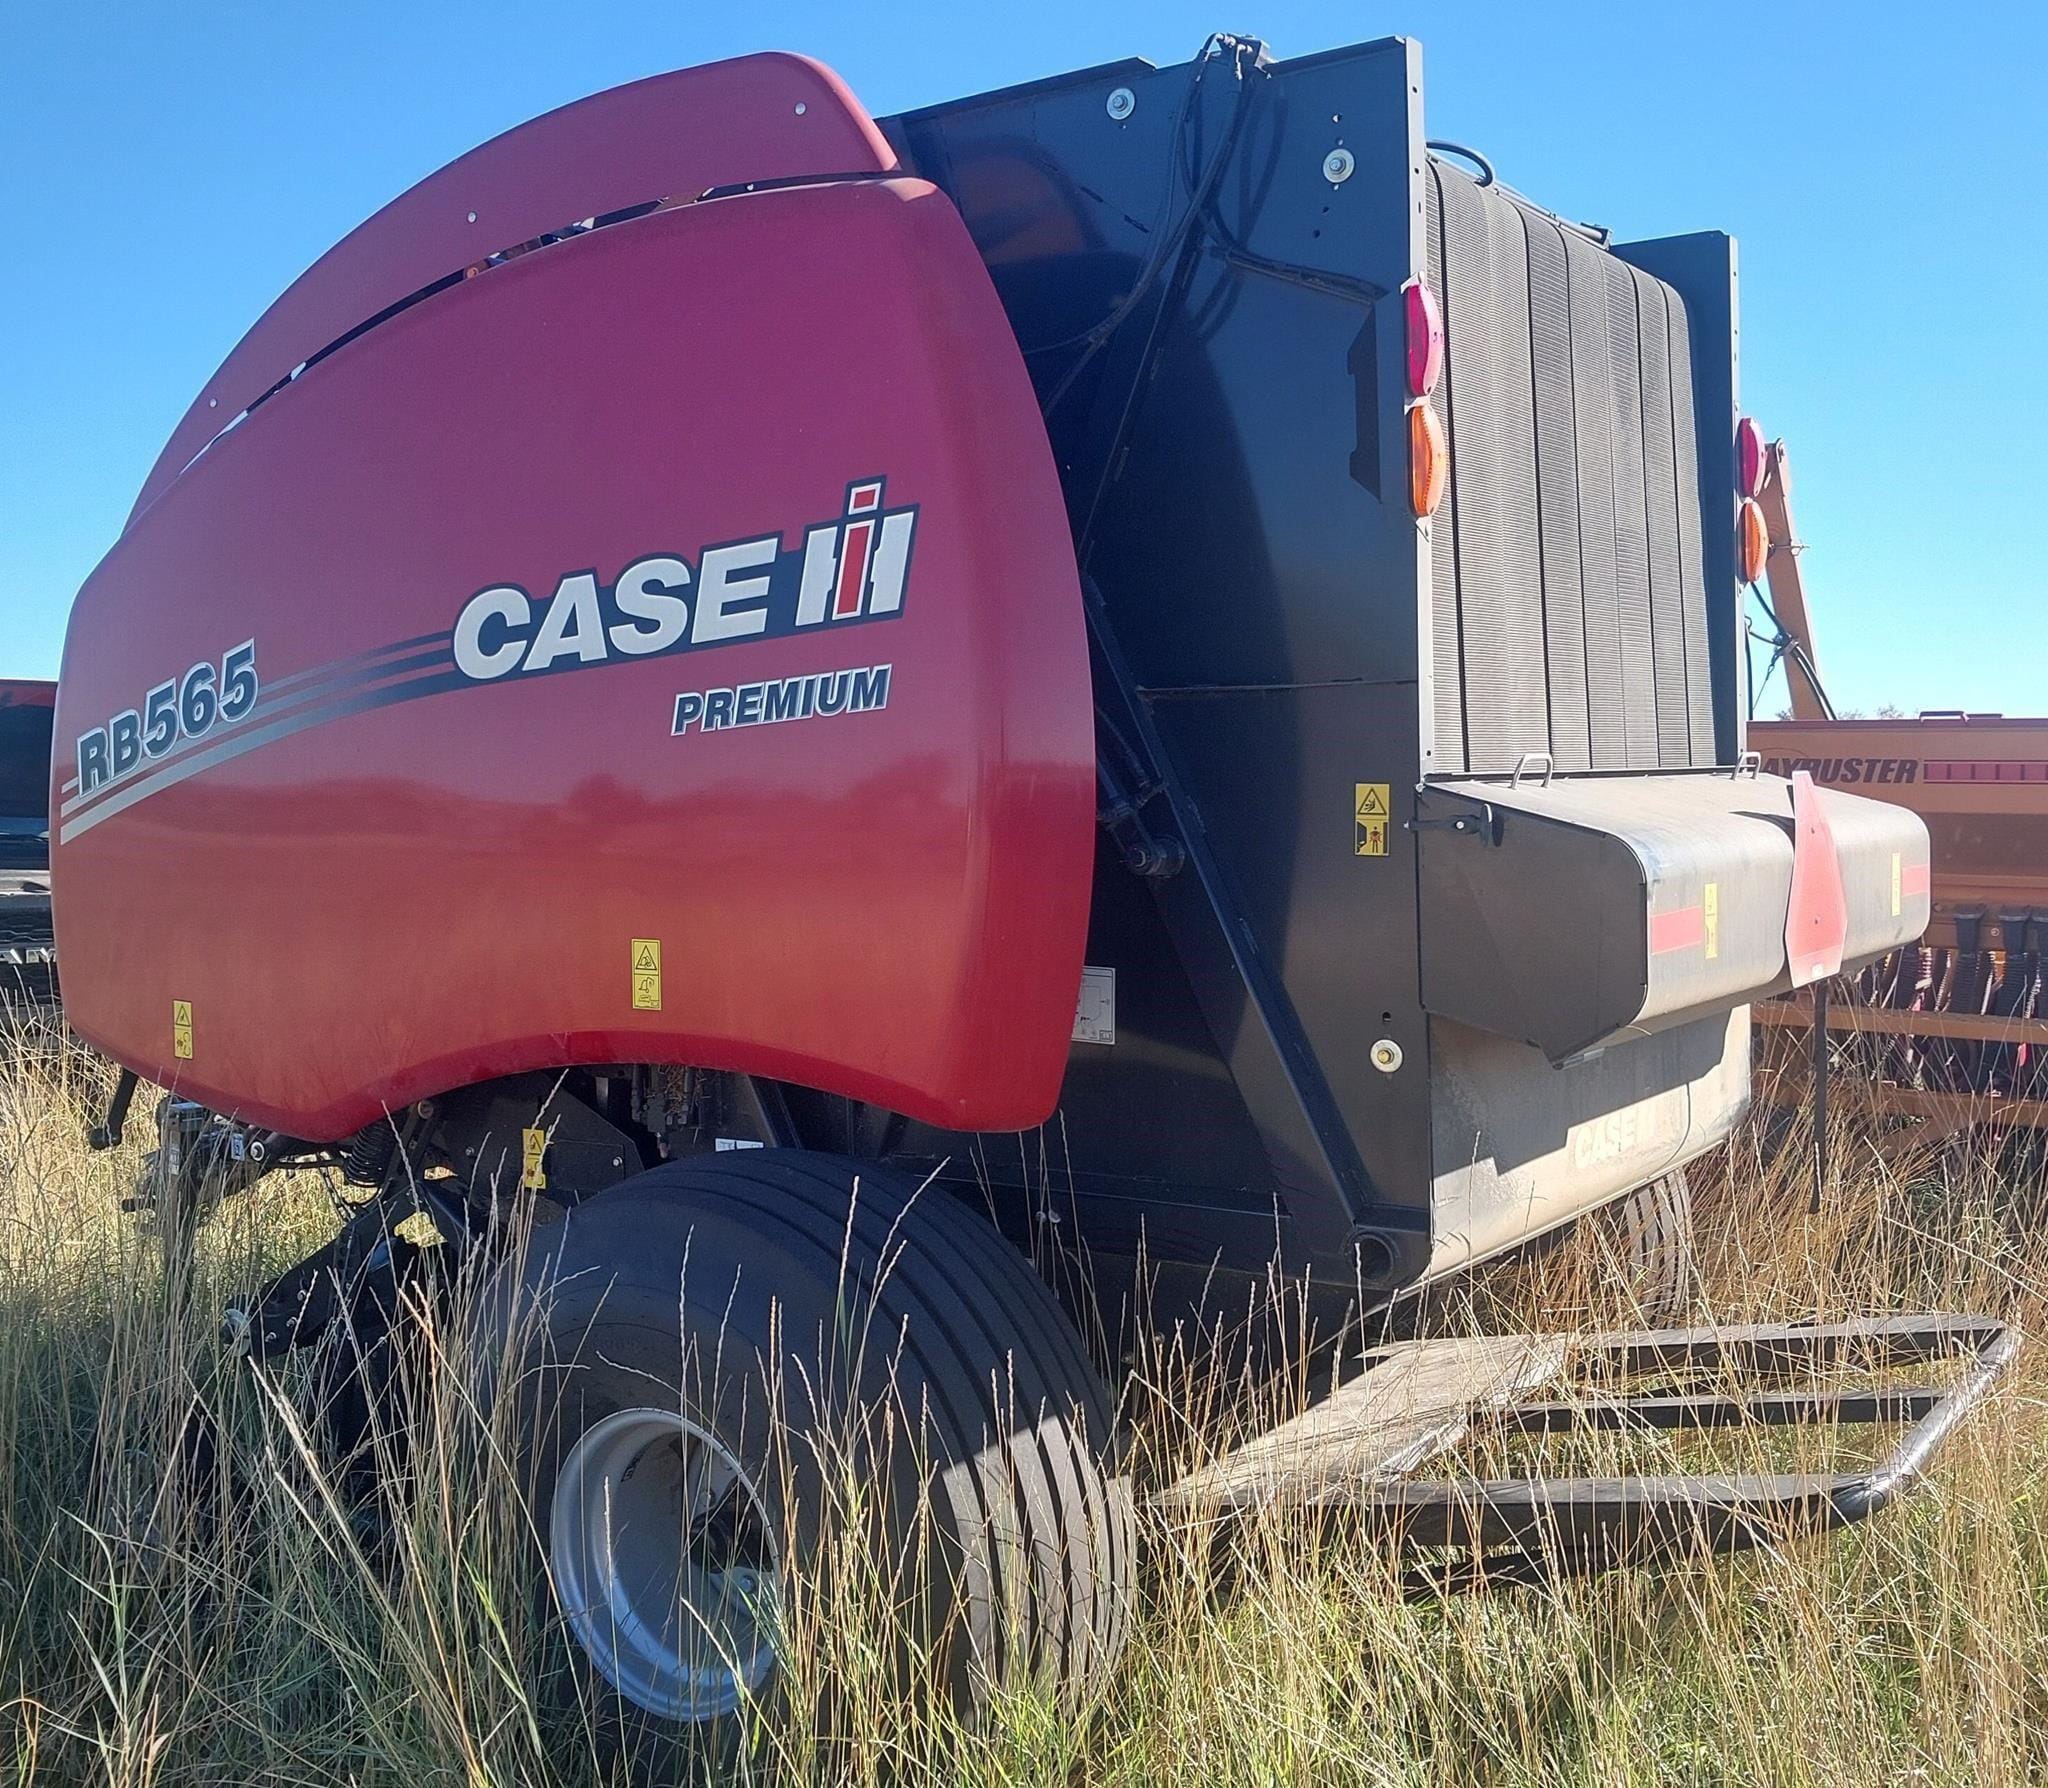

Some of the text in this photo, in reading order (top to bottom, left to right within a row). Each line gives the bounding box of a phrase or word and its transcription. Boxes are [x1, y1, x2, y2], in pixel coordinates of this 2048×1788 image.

[452, 536, 779, 680] CASE
[76, 637, 259, 799] RB565
[670, 663, 893, 737] PREMIUM
